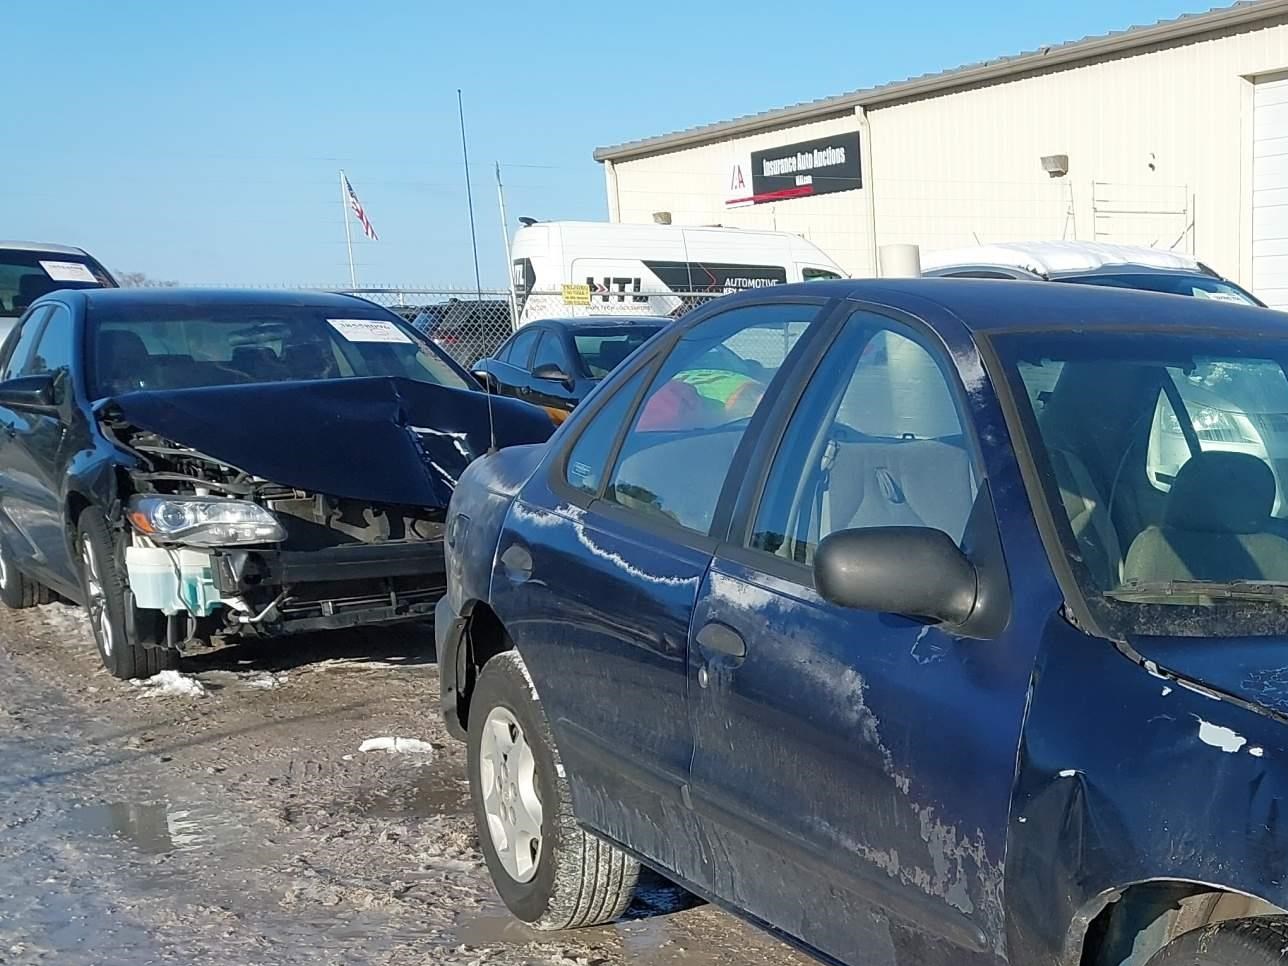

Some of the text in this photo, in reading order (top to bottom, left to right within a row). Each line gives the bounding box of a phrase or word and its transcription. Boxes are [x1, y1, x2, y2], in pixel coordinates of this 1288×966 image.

[763, 146, 845, 176] Insurance Auto Auctions
[586, 277, 648, 302] HTL
